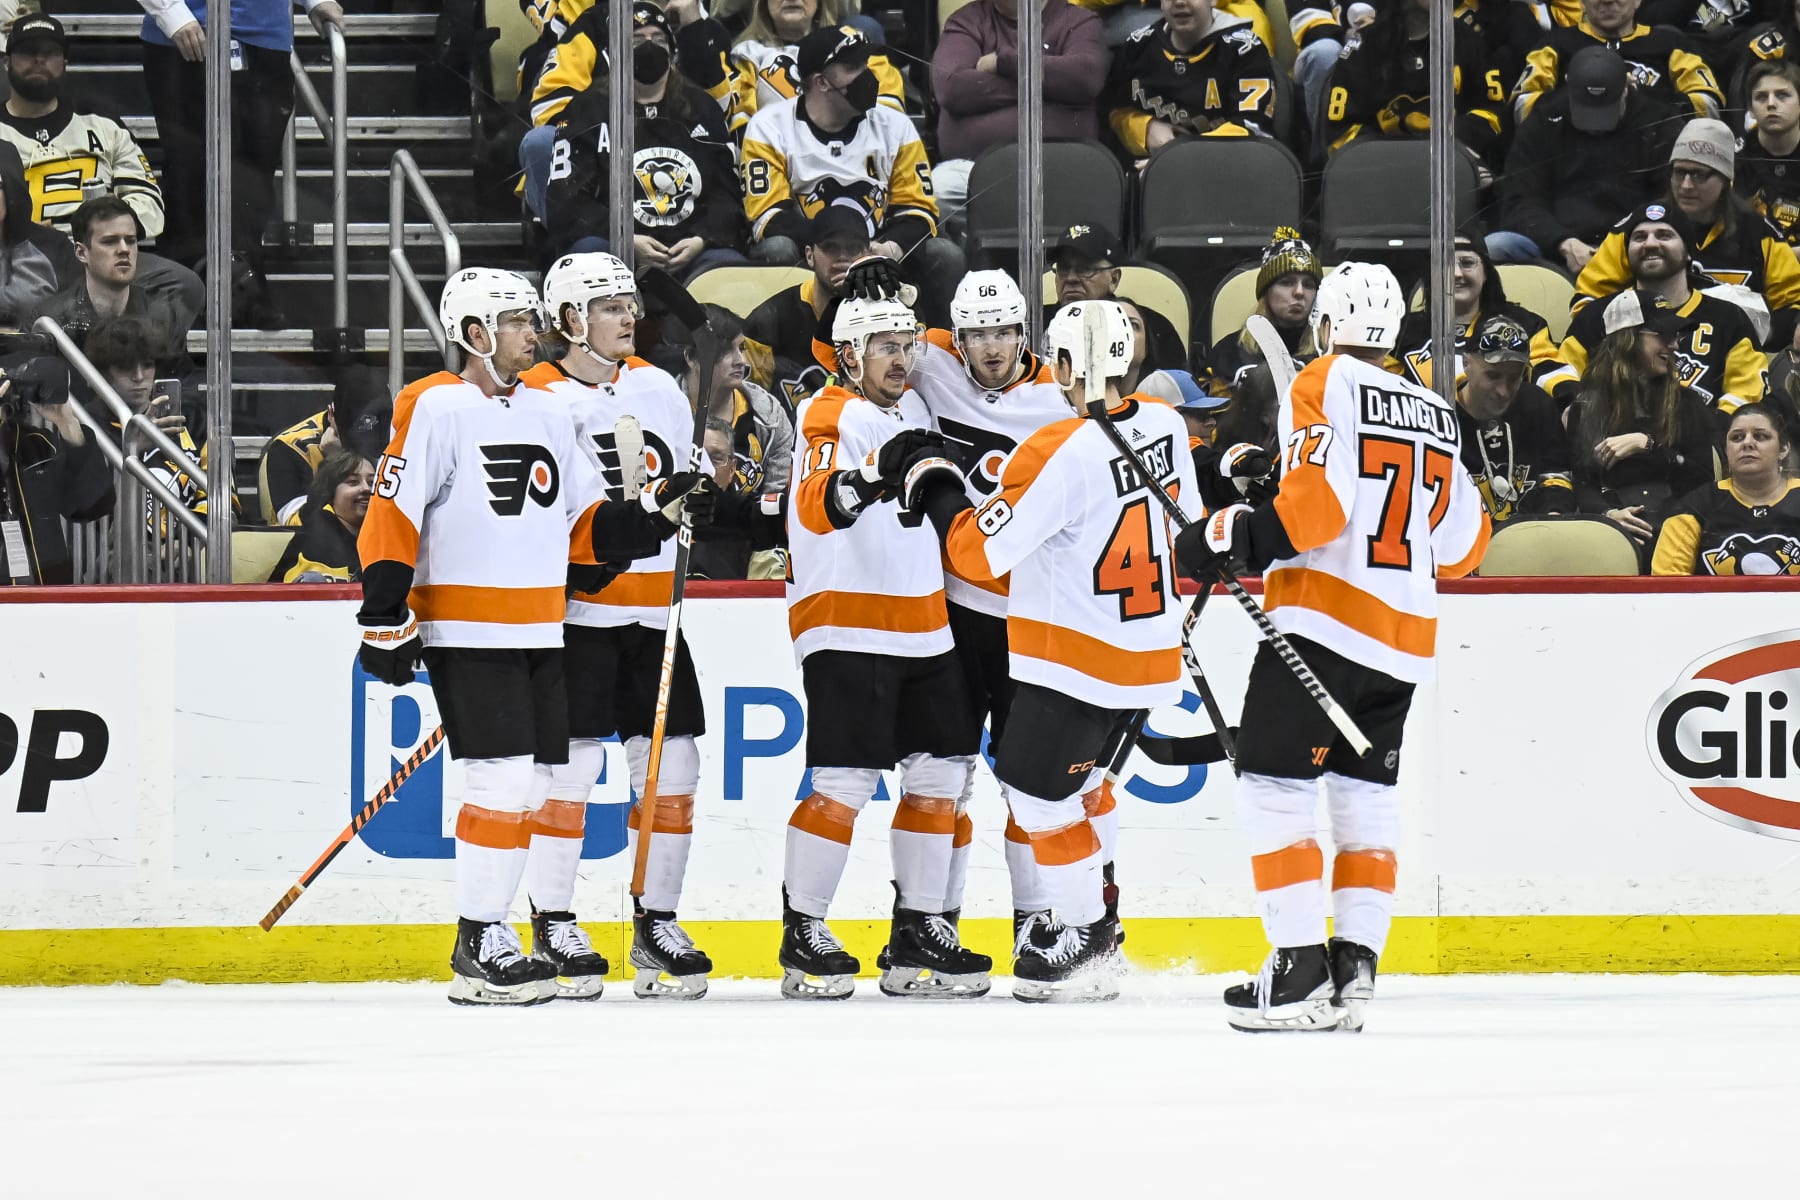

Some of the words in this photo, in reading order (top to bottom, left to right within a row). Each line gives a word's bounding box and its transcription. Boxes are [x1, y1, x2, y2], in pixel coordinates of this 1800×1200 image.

[1205, 78, 1221, 109] A
[1485, 69, 1504, 101] 5
[1328, 86, 1348, 121] 8
[87, 130, 104, 152] A
[598, 122, 610, 153] A
[1109, 341, 1125, 358] 48
[1366, 327, 1385, 343] 77
[1692, 322, 1713, 355] C
[1288, 424, 1334, 472] 77
[1358, 432, 1455, 578] 77
[1657, 690, 1800, 779] Gli
